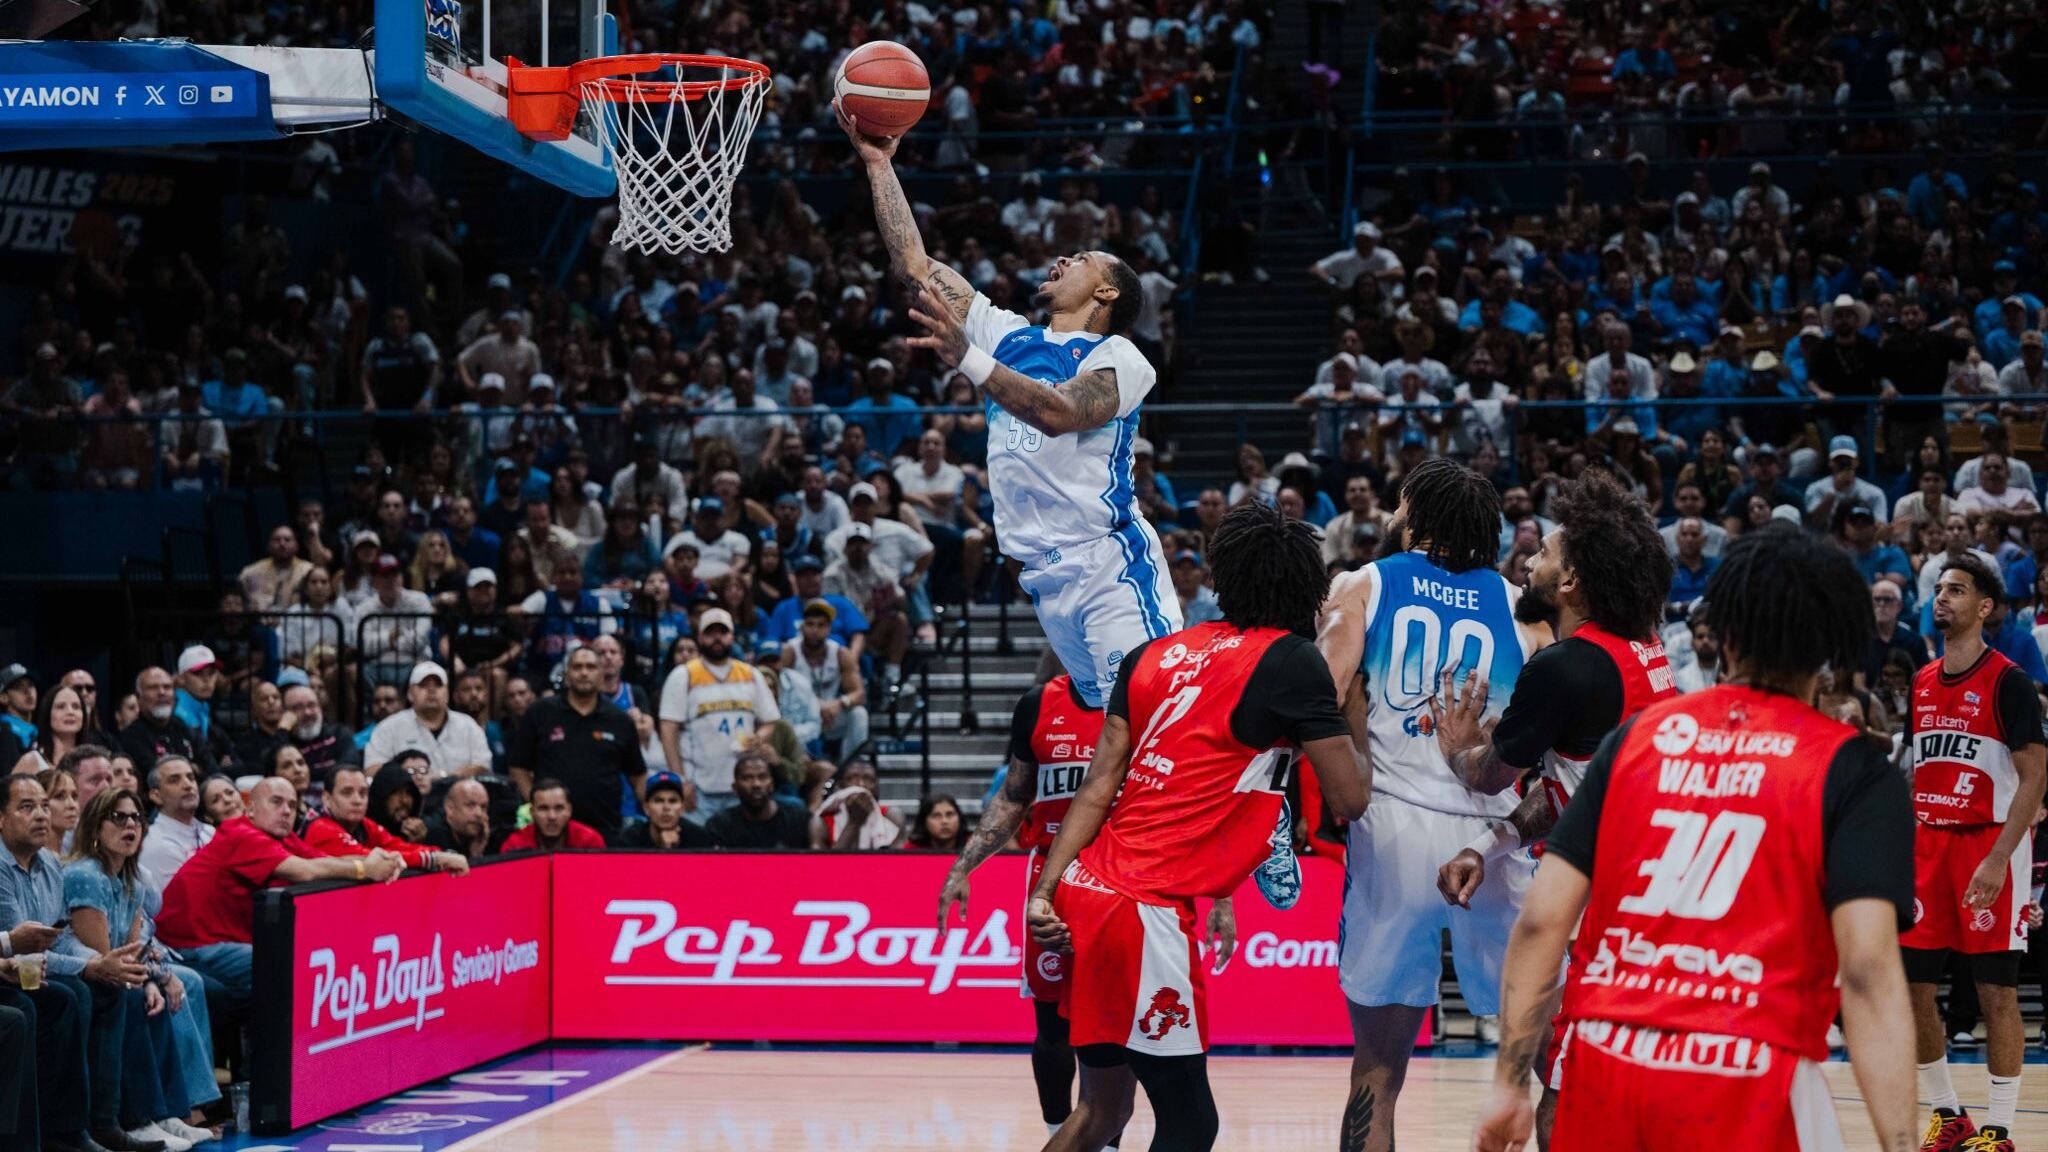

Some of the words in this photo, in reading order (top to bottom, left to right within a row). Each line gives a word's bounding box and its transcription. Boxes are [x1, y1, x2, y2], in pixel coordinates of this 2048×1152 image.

[0, 86, 99, 106] YAMON
[1412, 575, 1480, 611] MCGEE
[1385, 604, 1494, 712] 00
[1735, 731, 1797, 758] LUCAS
[1657, 757, 1766, 798] WALKER
[1953, 771, 1979, 796] 15
[1617, 808, 1767, 921] 30
[604, 900, 783, 980] Pep
[793, 901, 1021, 995] Boys
[1245, 931, 1340, 968] Gom
[309, 947, 370, 1040] Pep
[372, 932, 445, 1032] Boys
[452, 944, 495, 988] Servicio
[503, 938, 539, 975] Gomas
